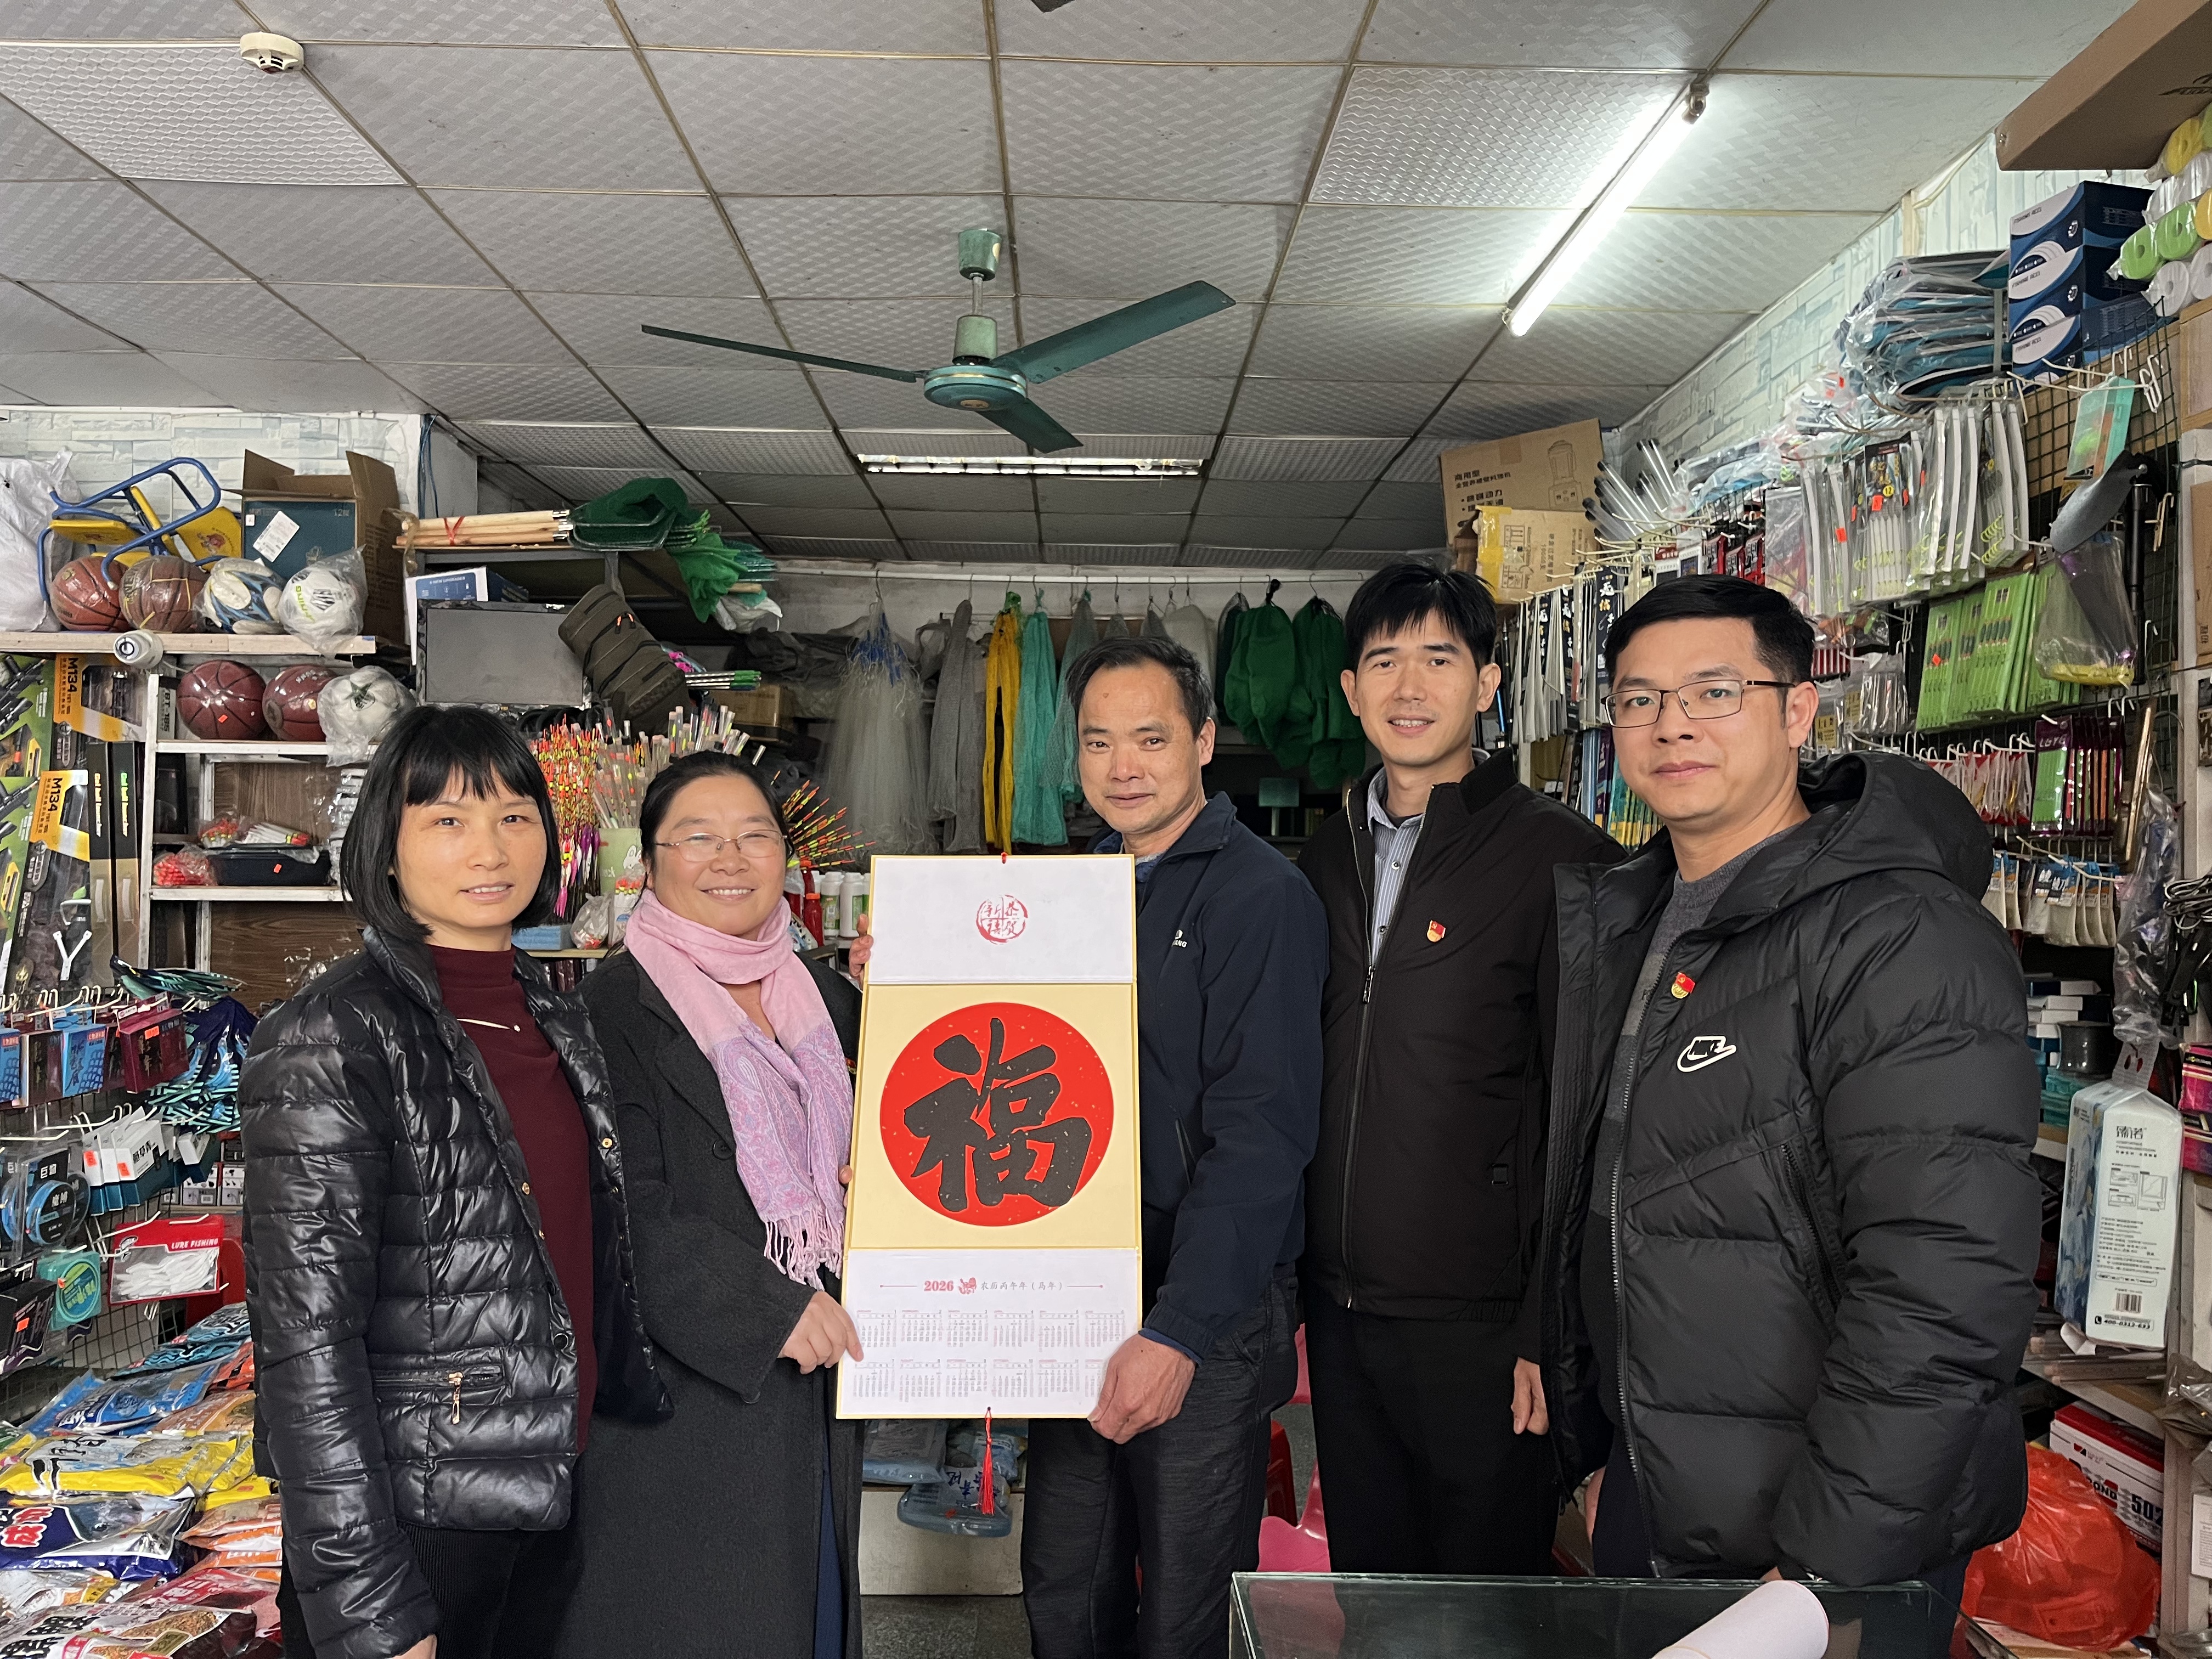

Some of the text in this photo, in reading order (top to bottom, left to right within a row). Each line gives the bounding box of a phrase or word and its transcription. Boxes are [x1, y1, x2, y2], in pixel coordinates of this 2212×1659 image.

[67, 657, 78, 692] M134
[48, 777, 63, 811] M134
[904, 1018, 1091, 1212] 福
[924, 1280, 954, 1291] 2026
[2132, 1493, 2163, 1527] 502
